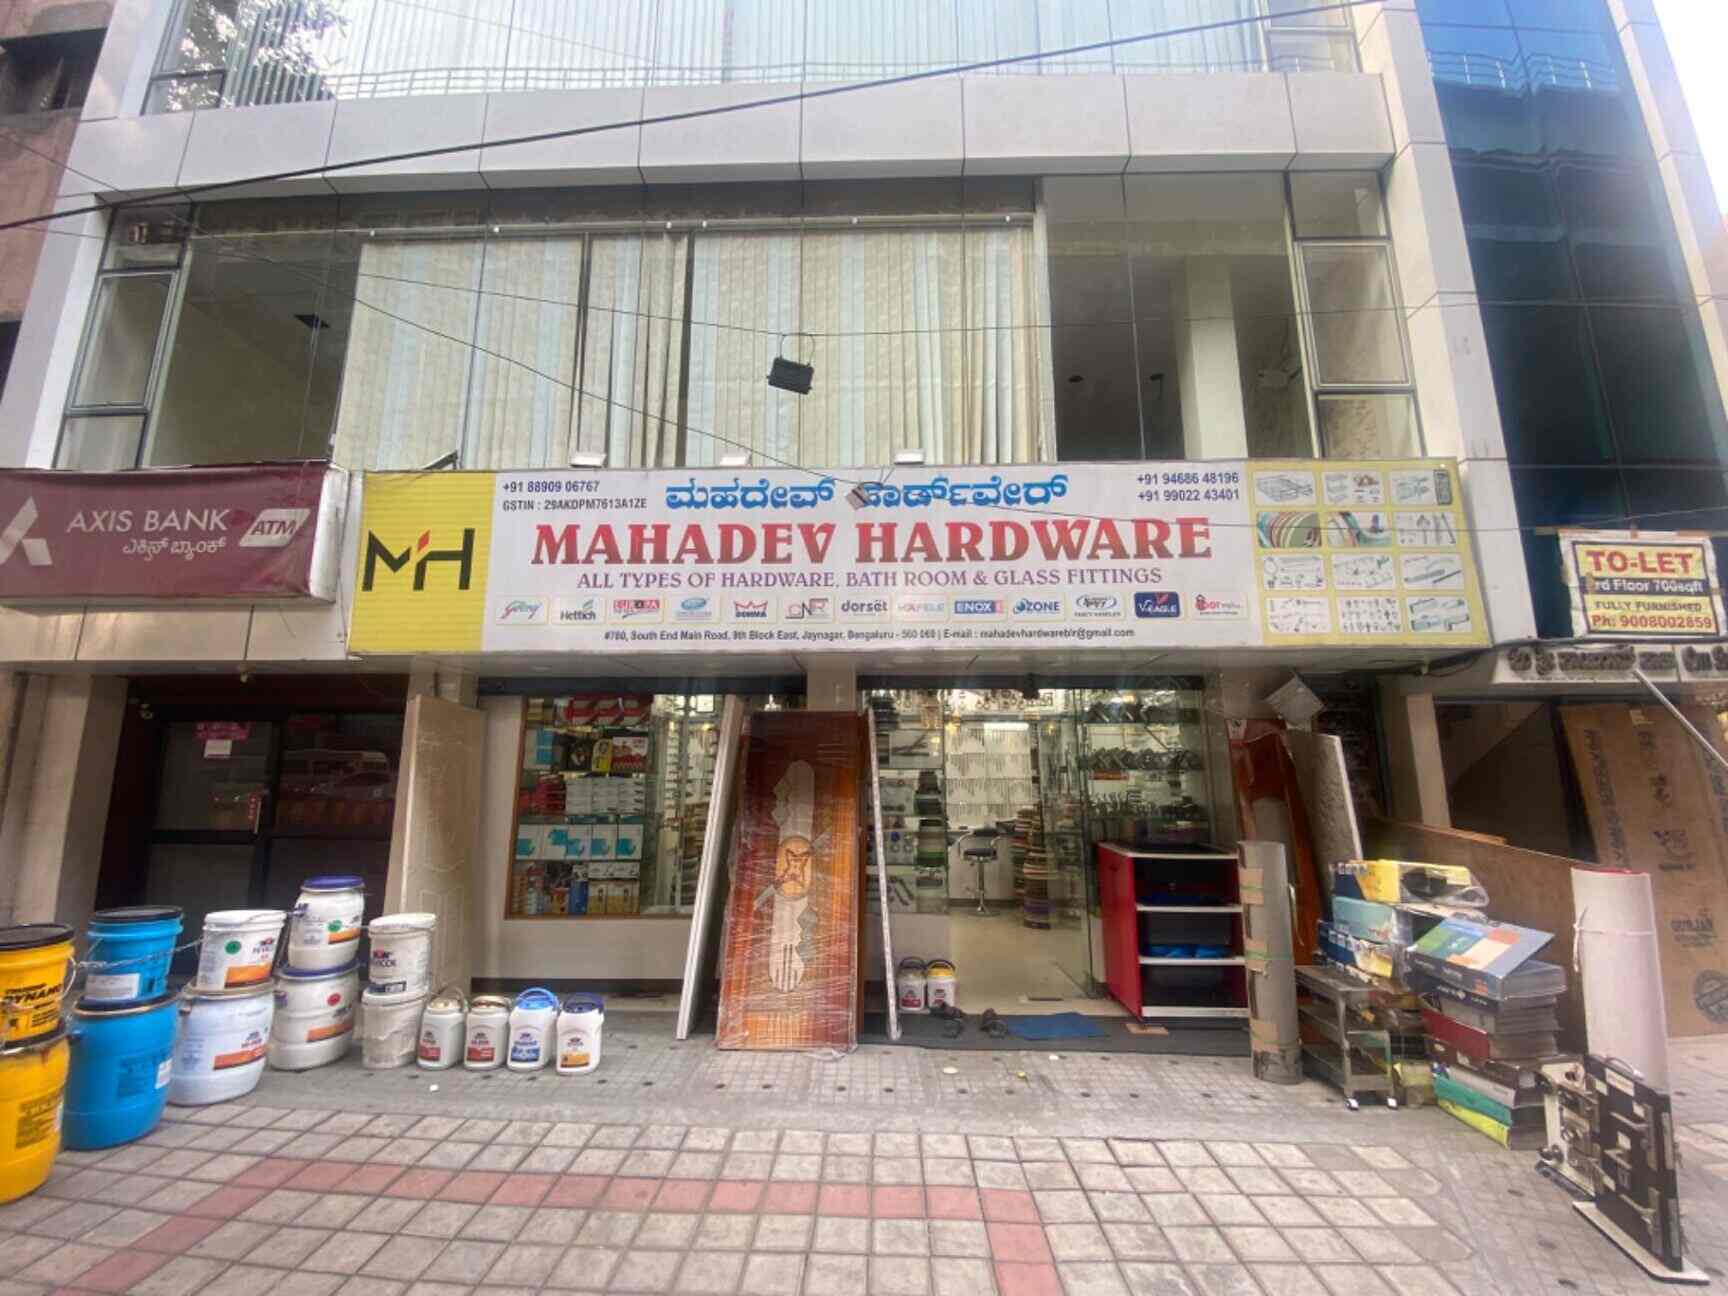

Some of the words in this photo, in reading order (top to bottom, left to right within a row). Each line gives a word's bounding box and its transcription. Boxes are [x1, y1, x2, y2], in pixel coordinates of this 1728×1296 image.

[1137, 473, 1158, 485] +91
[1202, 471, 1239, 483] 48196
[503, 481, 523, 492] +91
[527, 480, 561, 492] 88909
[565, 480, 599, 492] 06767
[1138, 489, 1159, 502] +91
[1163, 489, 1200, 501] 99022
[1203, 488, 1239, 500] 43401
[503, 500, 534, 511] GSTIN
[66, 509, 133, 532] AXIS
[144, 508, 231, 532] BANK
[251, 519, 298, 536] ATM
[530, 523, 836, 566] MAHADEV
[855, 517, 1212, 563] HARDWARE
[1585, 549, 1693, 574] TO-LET
[577, 572, 613, 588] ALL
[620, 572, 682, 588] TYPES
[688, 572, 715, 588] OF
[846, 571, 897, 587] BATH
[904, 570, 966, 586] ROOM
[973, 570, 988, 586] &
[994, 569, 1061, 586] GLASS
[1067, 567, 1162, 584] FITTINGS
[1614, 578, 1649, 591] Floor
[1592, 615, 1616, 628] Ph:
[631, 631, 657, 641] South
[660, 630, 677, 641] End
[680, 630, 701, 641] Main
[749, 630, 773, 640] Block
